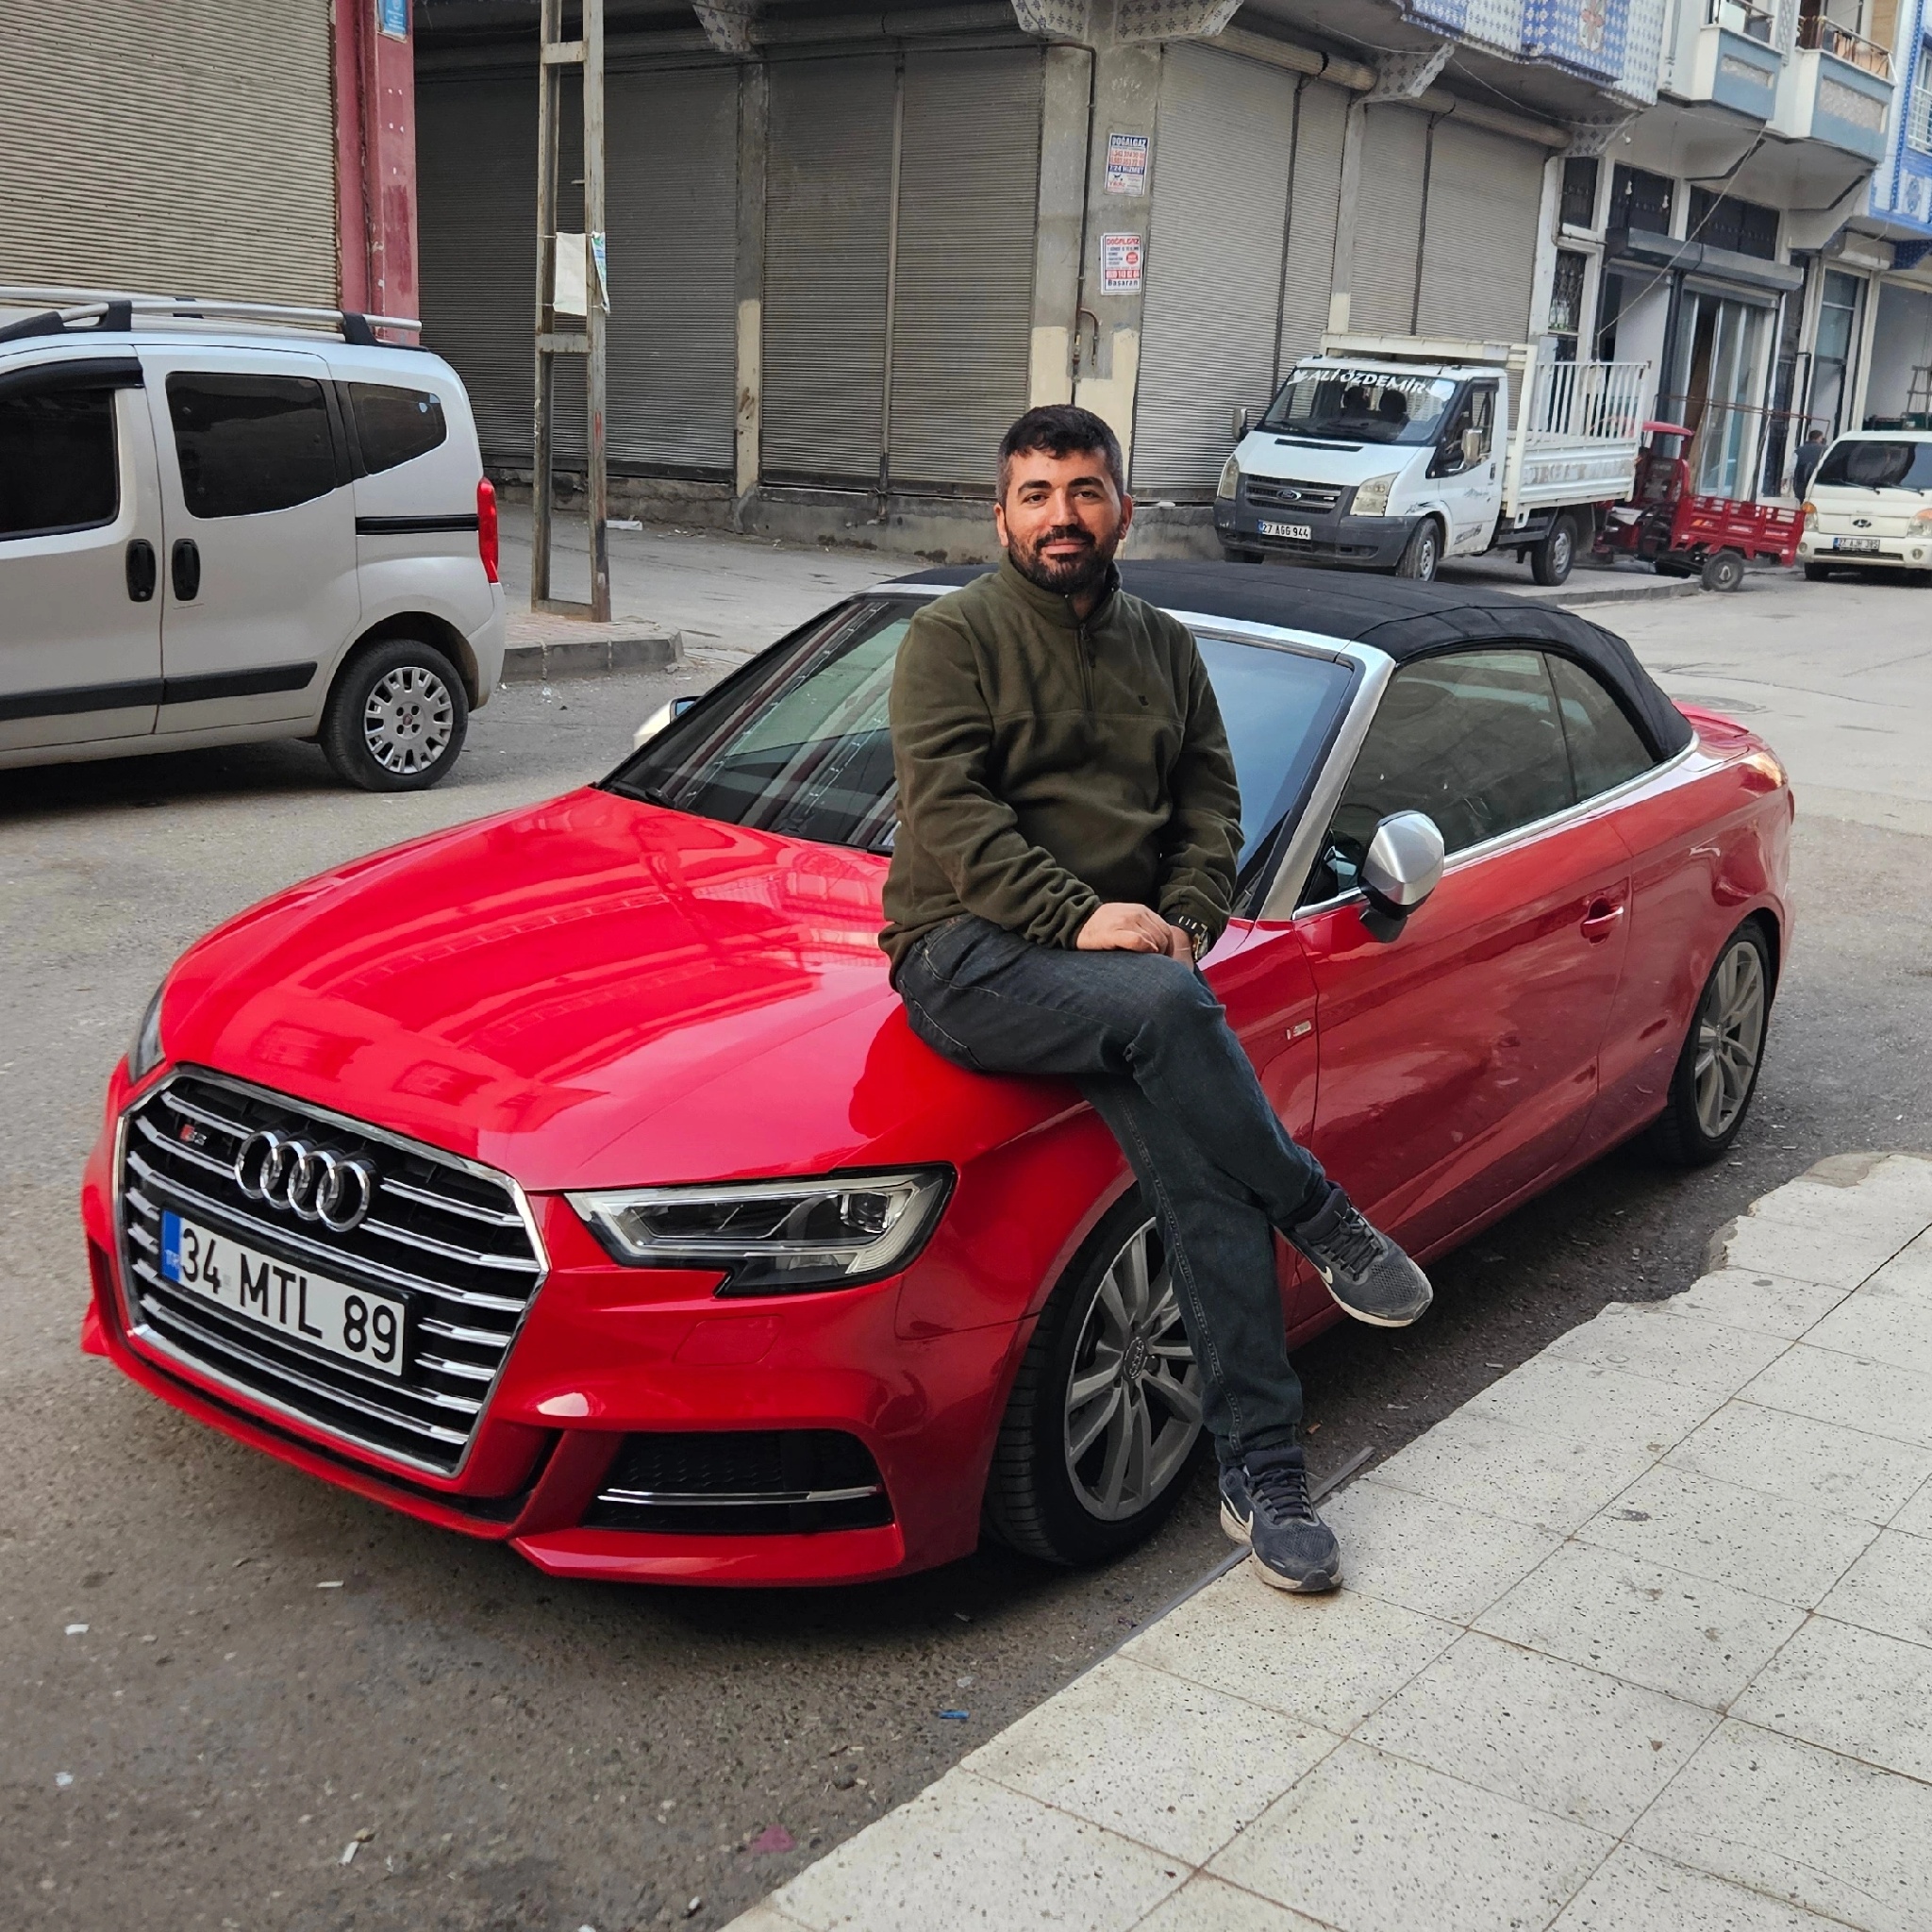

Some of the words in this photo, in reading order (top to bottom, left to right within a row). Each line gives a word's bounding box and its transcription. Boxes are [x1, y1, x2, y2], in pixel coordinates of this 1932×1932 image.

[1112, 136, 1147, 148] DOĞALGAZ
[1308, 368, 1341, 382] ALİ
[1340, 368, 1426, 394] ÖZDEMİR
[1263, 524, 1273, 533] 27
[1275, 525, 1291, 535] AGG
[1292, 527, 1308, 538] 944
[182, 1227, 222, 1294] 34
[240, 1252, 323, 1340] MTL
[343, 1295, 398, 1363] 89
